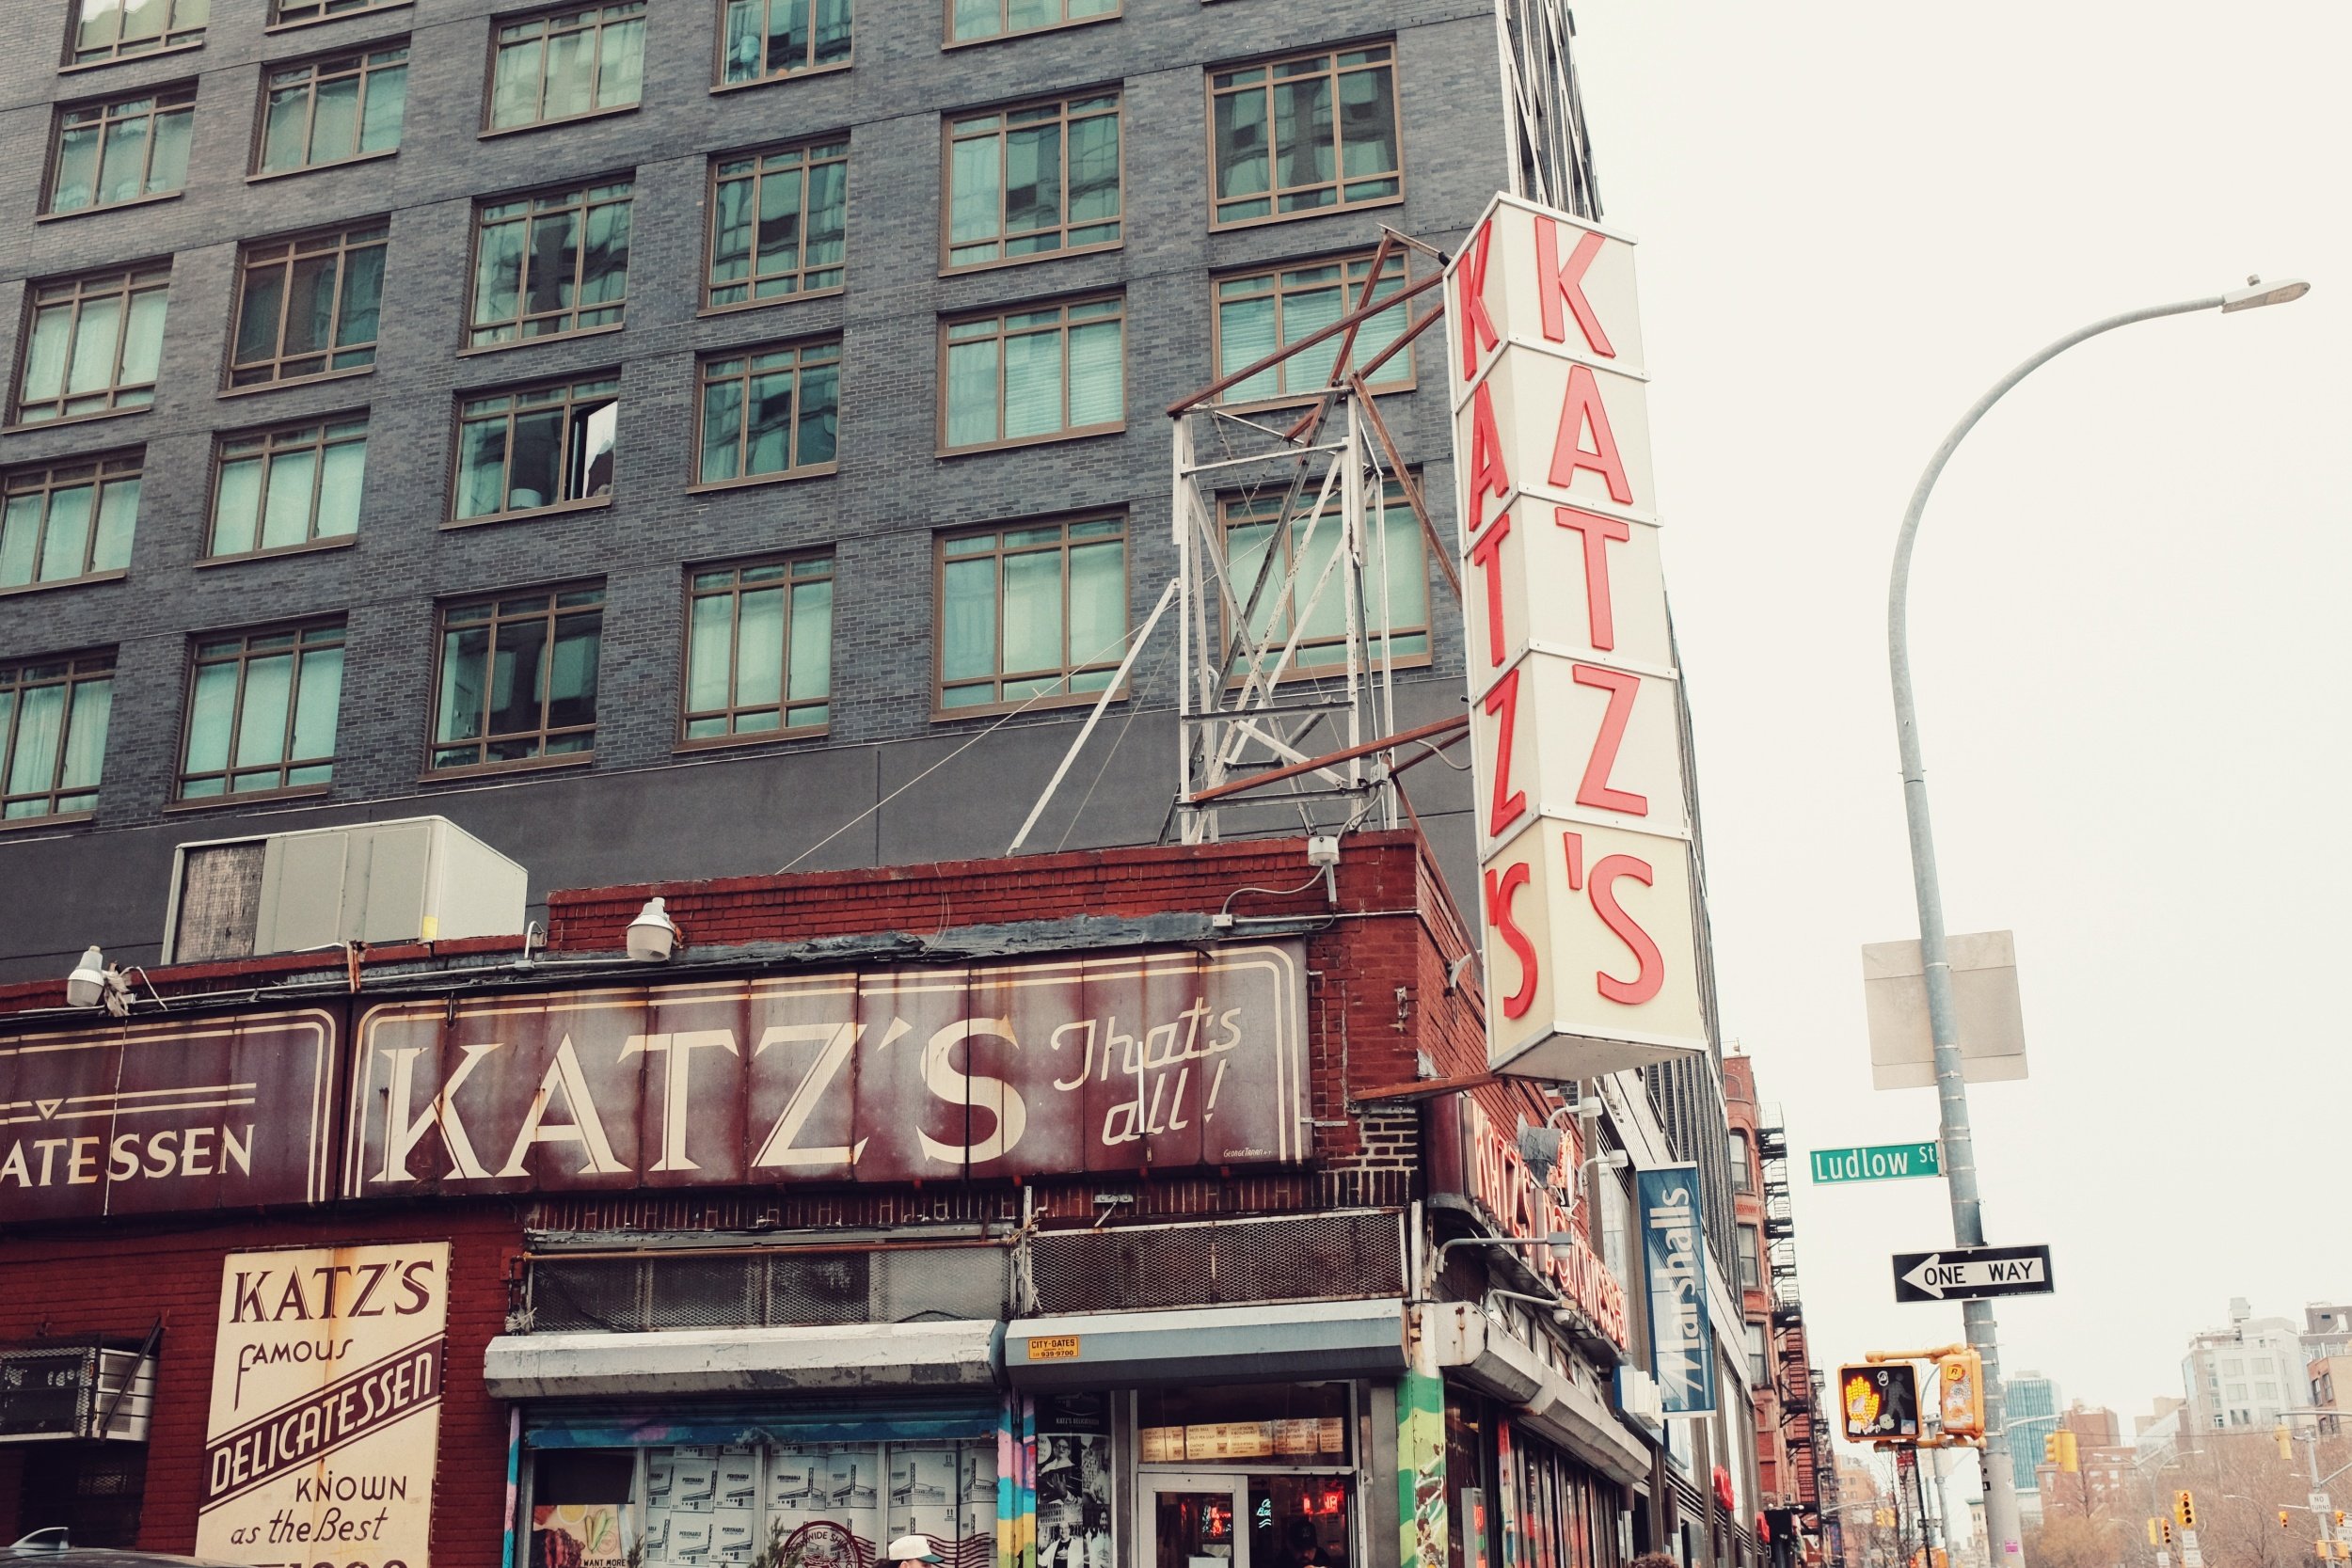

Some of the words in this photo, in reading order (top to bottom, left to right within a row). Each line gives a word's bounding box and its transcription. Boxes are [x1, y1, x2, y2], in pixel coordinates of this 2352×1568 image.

[1458, 219, 1538, 1021] KATZ'S
[1534, 215, 1664, 1006] KATZ'S
[1051, 997, 1242, 1091] That's
[368, 1015, 1027, 1182] KATZ'S
[0, 1124, 255, 1187] ATESSEN
[1815, 1148, 1908, 1180] Ludlow
[1918, 1146, 1935, 1163] St
[230, 1259, 434, 1323] KATZ'S
[1649, 1188, 1703, 1392] Marshalls
[1924, 1265, 1966, 1286] ONE
[1988, 1260, 2033, 1283] WAY
[1031, 1338, 1075, 1349] CITY-GATES
[210, 1352, 433, 1497] DELICATESSEN
[295, 1475, 407, 1502] KNOWN
[230, 1526, 261, 1544] as
[268, 1509, 311, 1544] the
[313, 1507, 389, 1543] Best
[583, 1559, 603, 1567] WANT
[606, 1559, 626, 1567] MORE
